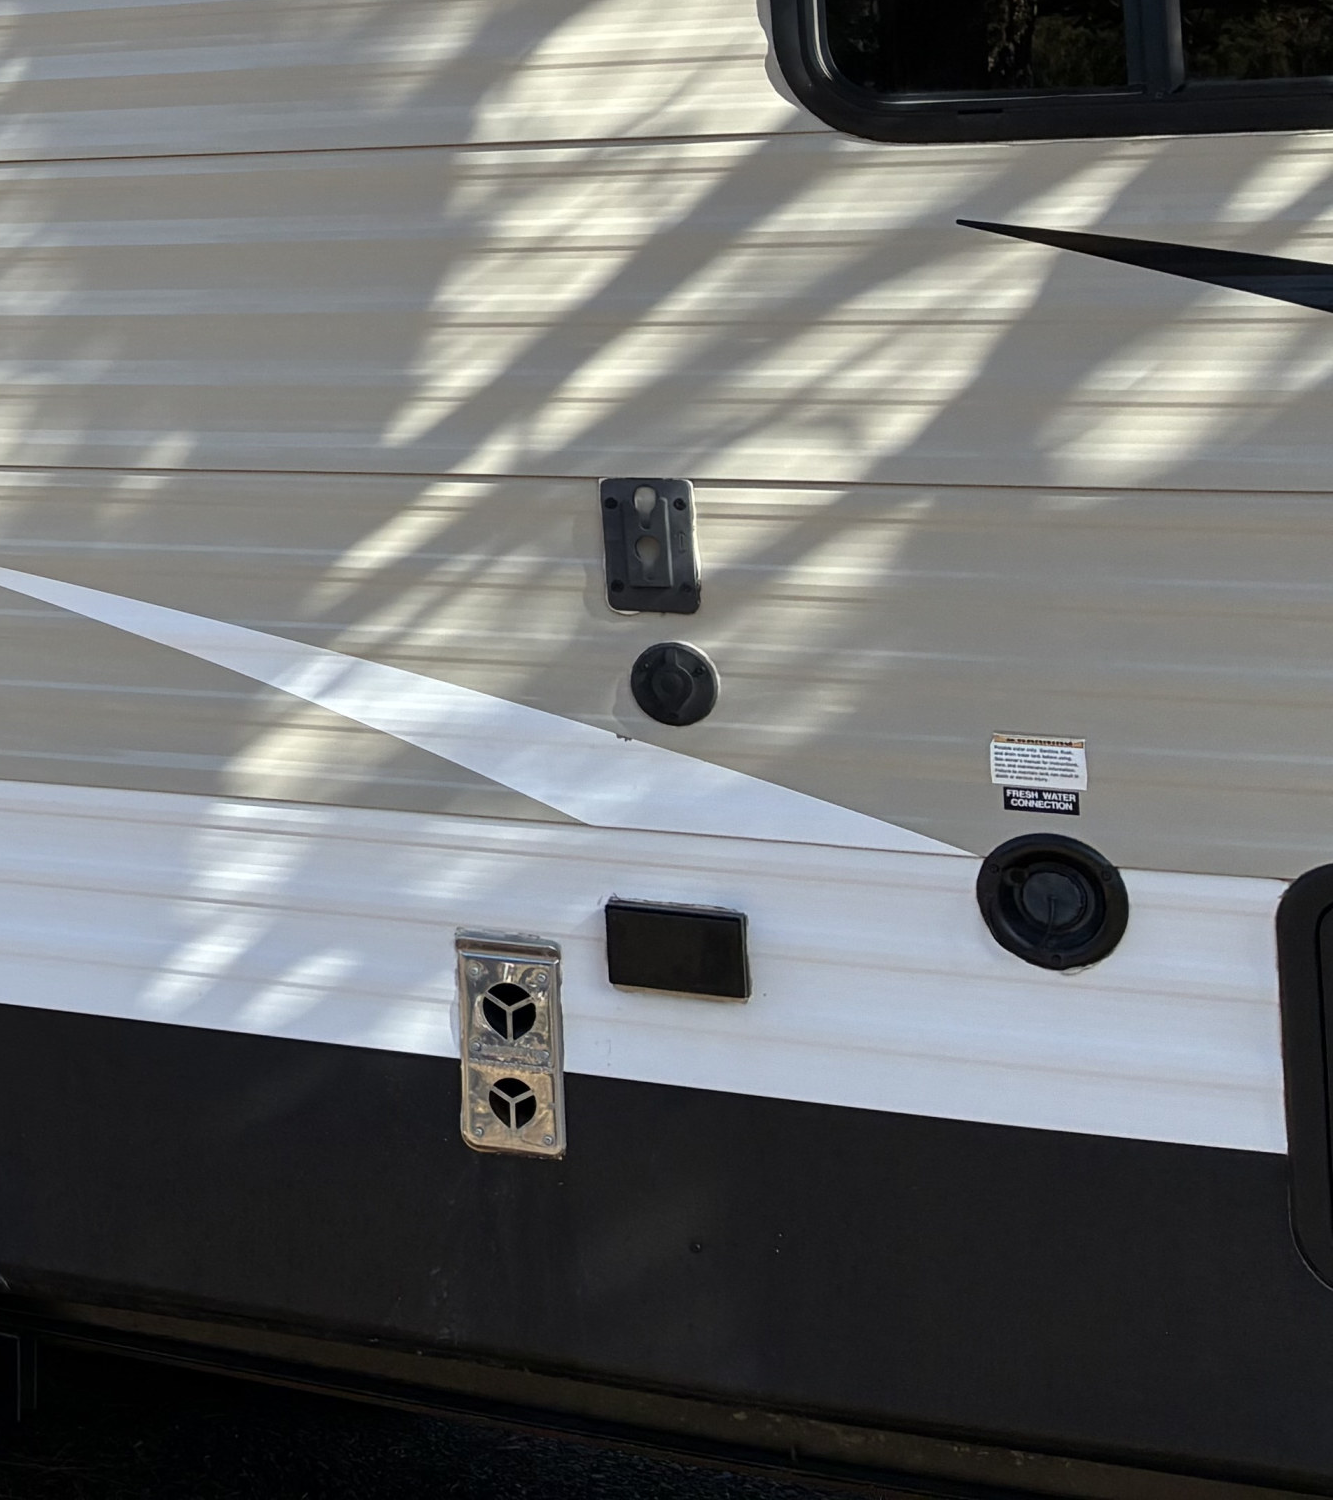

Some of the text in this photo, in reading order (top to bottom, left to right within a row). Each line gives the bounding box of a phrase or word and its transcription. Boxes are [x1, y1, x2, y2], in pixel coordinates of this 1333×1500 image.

[1006, 789, 1076, 802] FRESH WATER
[1011, 799, 1073, 810] CONNECTION
